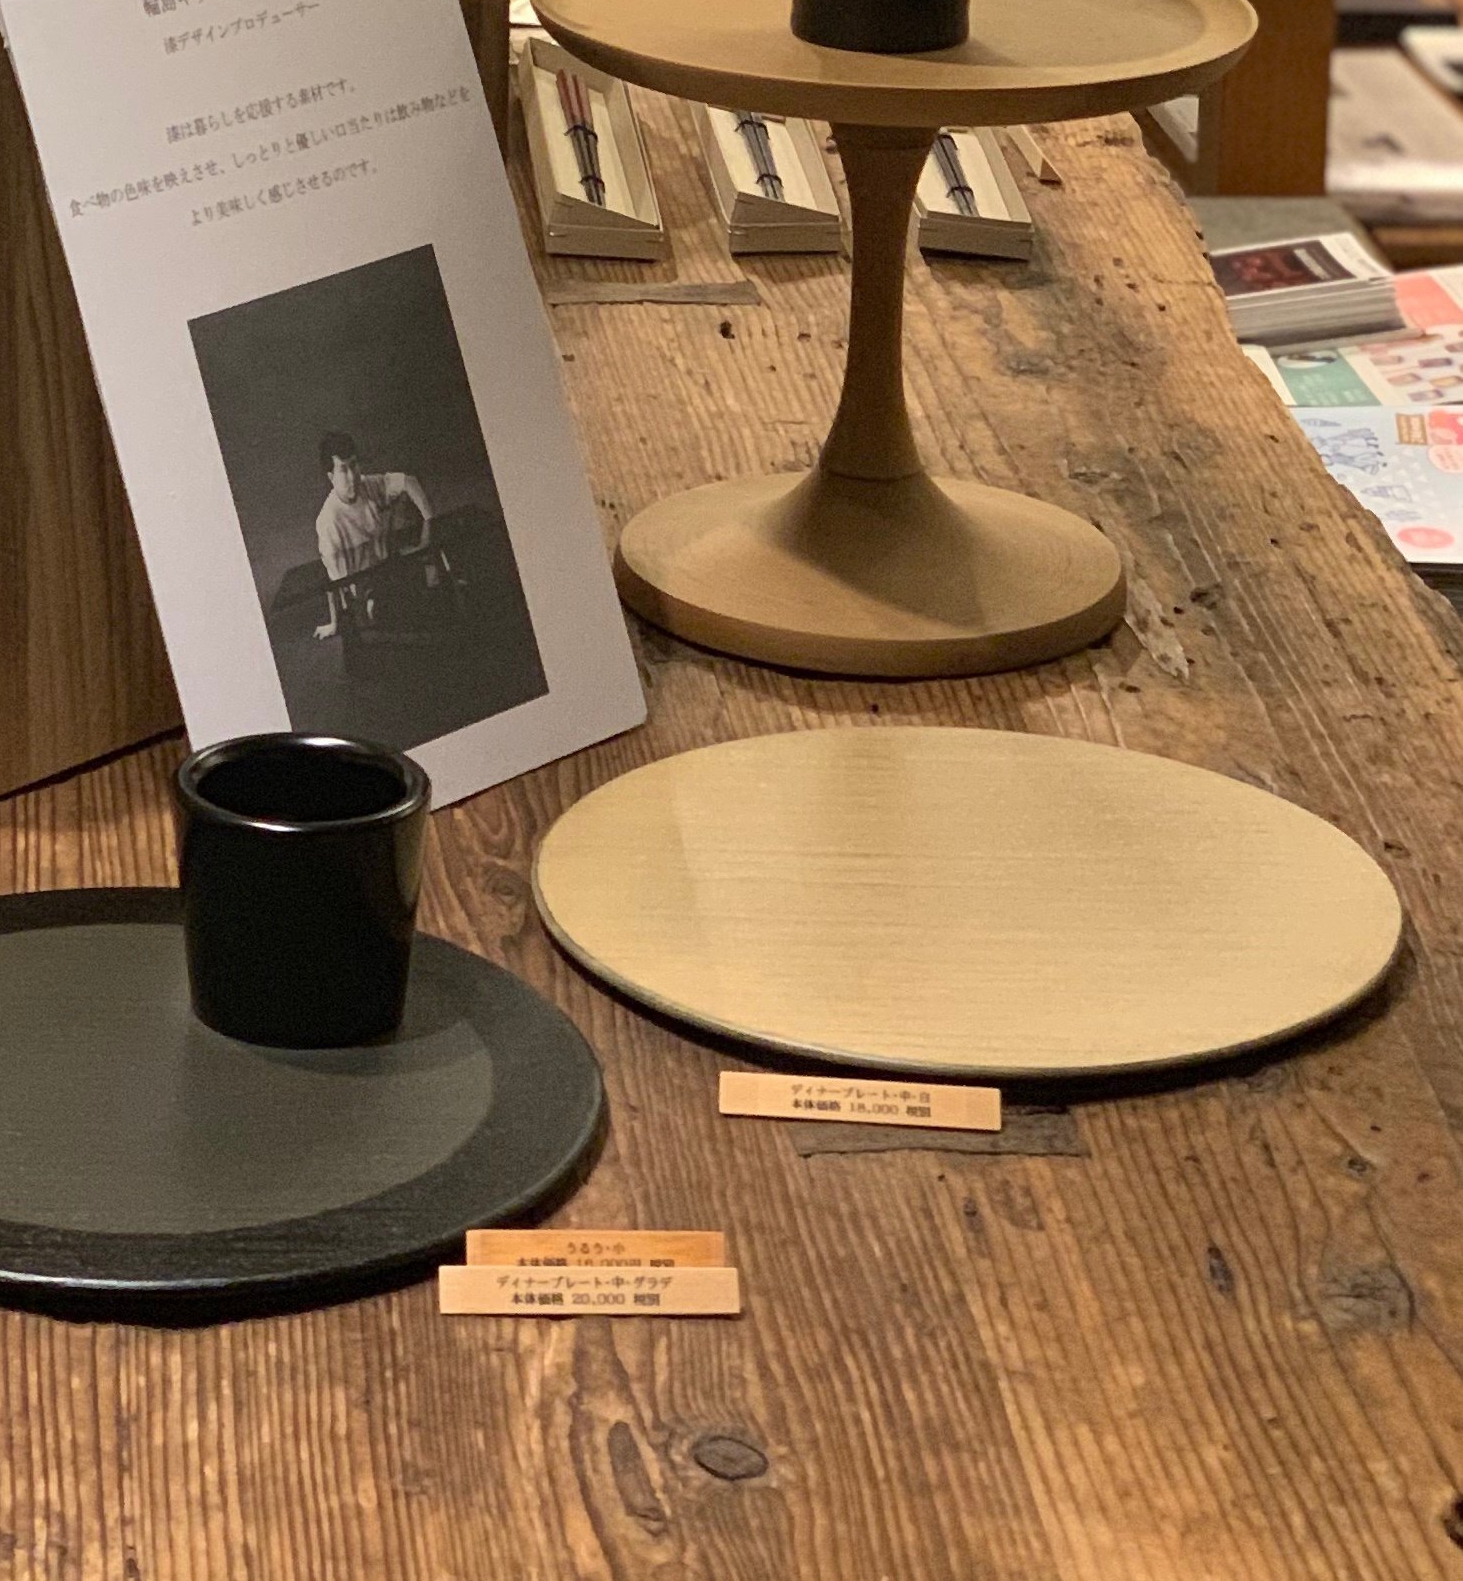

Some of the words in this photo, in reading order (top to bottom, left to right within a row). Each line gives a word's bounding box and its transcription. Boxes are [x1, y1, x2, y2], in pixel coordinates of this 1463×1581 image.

[163, 2, 320, 54] 漆デザインプロデューサー
[165, 77, 356, 144] 漆は暮らしを応援する素材です。
[191, 158, 378, 226] より美味しく感じさせるのです。
